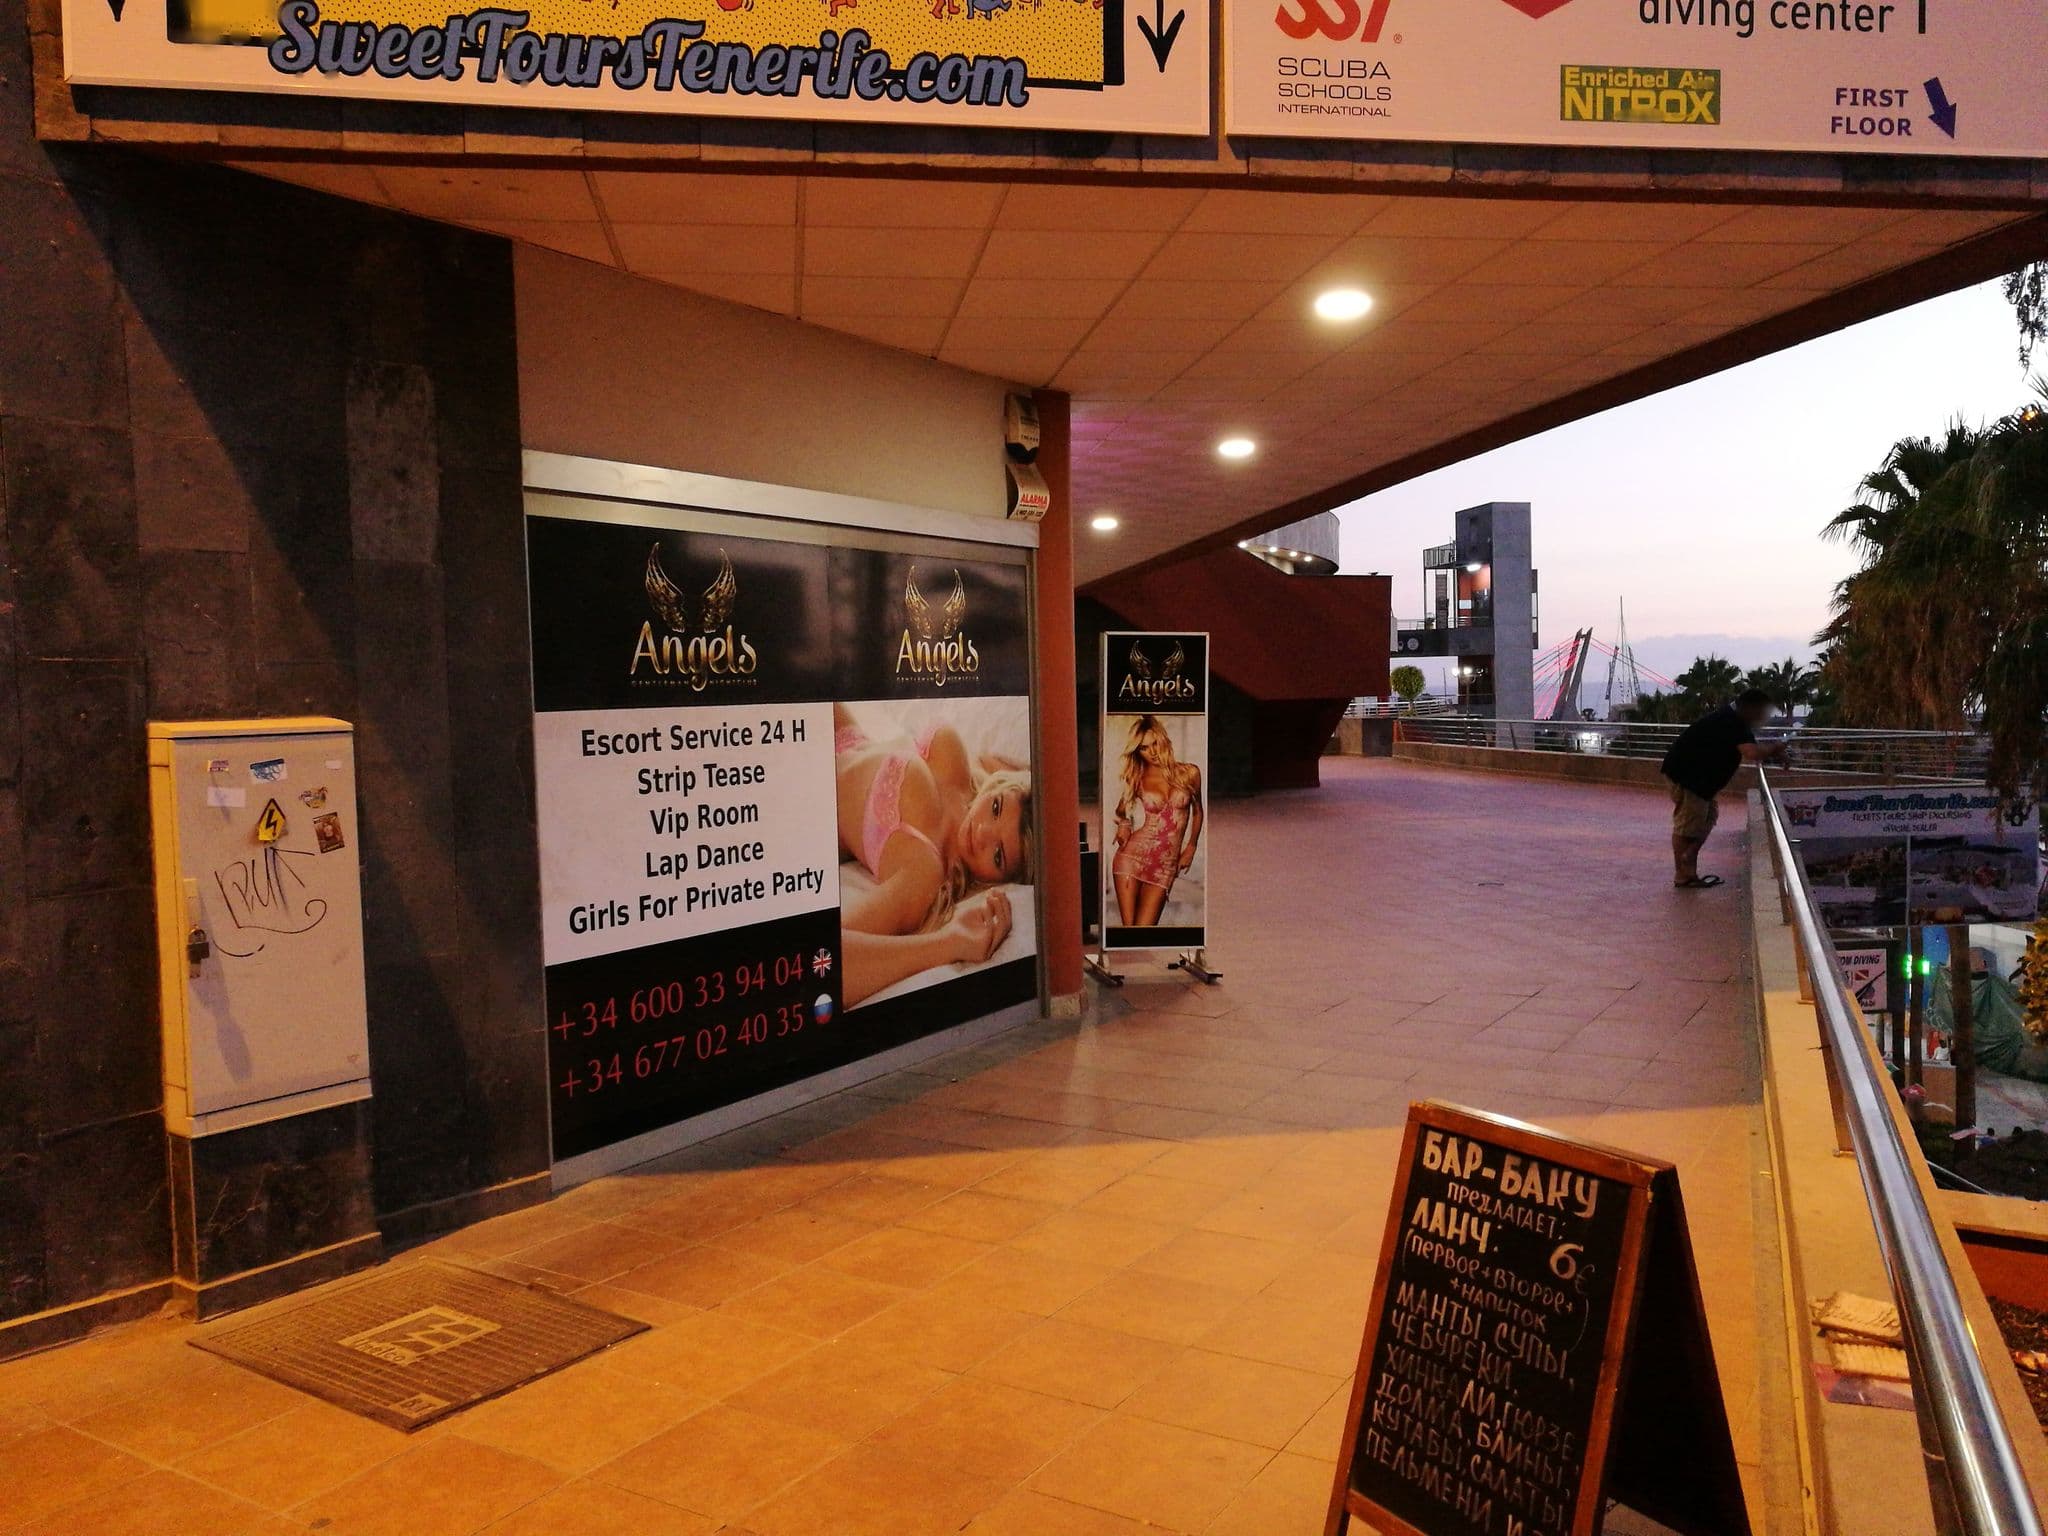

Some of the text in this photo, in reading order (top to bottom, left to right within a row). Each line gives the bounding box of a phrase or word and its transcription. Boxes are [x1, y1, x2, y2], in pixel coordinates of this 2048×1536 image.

[1639, 0, 1894, 37] diving center
[268, 0, 1030, 107] SweetToursTenerife.com
[1278, 57, 1391, 79] SCUBA
[1278, 83, 1392, 101] SCHOOLS
[1564, 66, 1669, 90] Enriched
[1278, 104, 1391, 117] INTERNATIONAL
[1564, 87, 1716, 123] NITROX
[1835, 88, 1909, 108] FIRST
[1830, 116, 1912, 137] FLOOR
[630, 620, 757, 692] Angels
[896, 628, 979, 687] Angels
[1118, 672, 1196, 705] Angels
[581, 718, 806, 757] Escort Service 24 H
[637, 763, 766, 797] Strip Tease
[650, 803, 759, 839] Vip Room
[646, 841, 764, 880] Lap Dance
[569, 866, 825, 934] Girls For Private Party
[1853, 954, 1881, 965] DIVING
[630, 981, 684, 1024] 600
[694, 972, 726, 1007] 33
[735, 962, 766, 996] 94
[774, 953, 804, 986] 04
[635, 1036, 687, 1078] 677
[696, 1024, 728, 1060] 02
[736, 1012, 768, 1046] 40
[776, 1002, 805, 1037] 35
[1422, 1130, 1600, 1219] БАР-БАКУ
[1411, 1196, 1503, 1254] ЛАНЧ:
